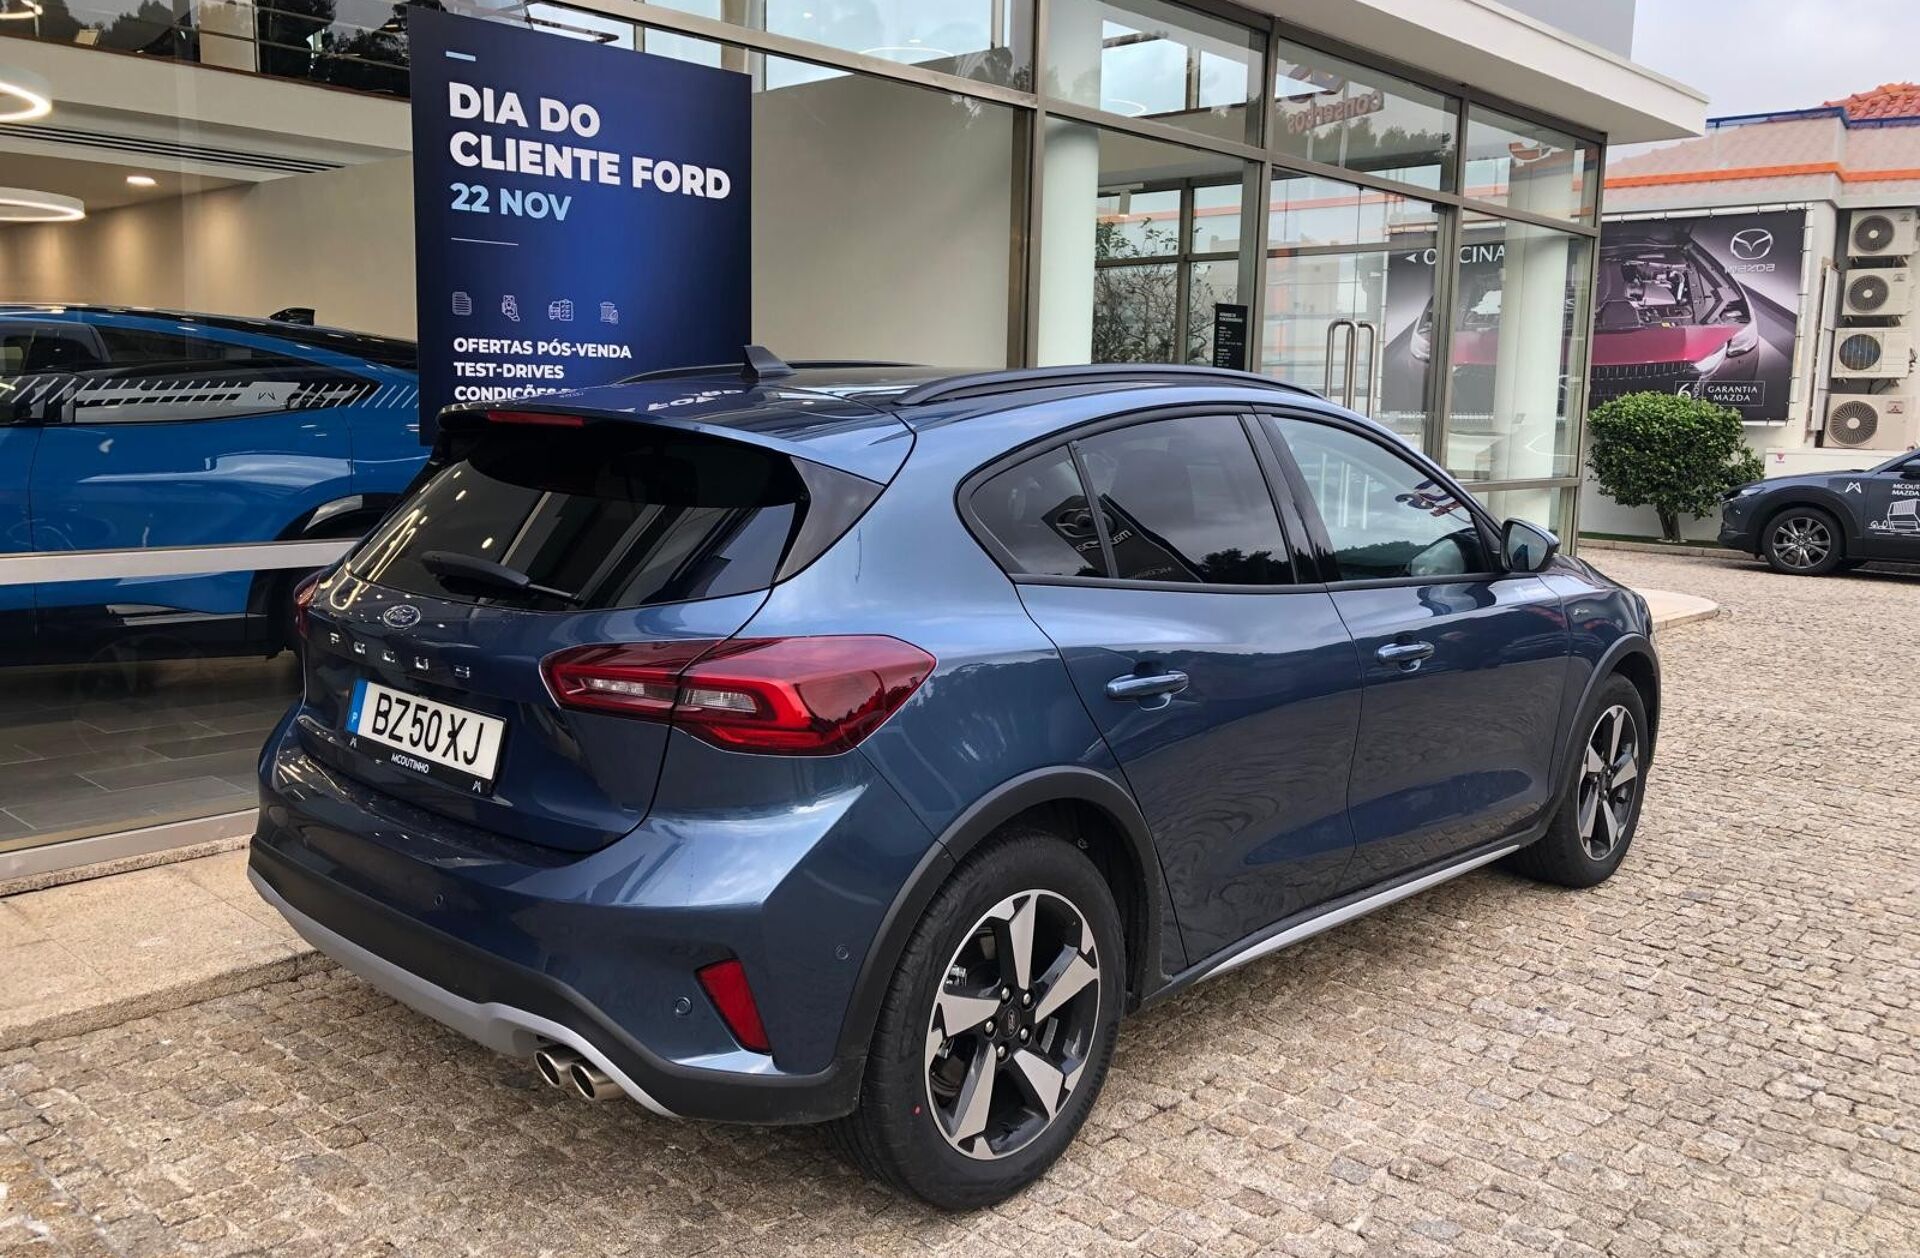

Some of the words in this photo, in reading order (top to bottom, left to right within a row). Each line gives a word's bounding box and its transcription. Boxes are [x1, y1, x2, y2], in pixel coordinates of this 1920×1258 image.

[449, 81, 528, 128] DIA
[540, 97, 600, 138] DO
[449, 131, 621, 186] CLIENTE
[632, 156, 731, 199] FORD
[450, 183, 490, 213] 22
[500, 188, 572, 221] NOV
[1423, 244, 1505, 265] OCINA
[453, 337, 533, 355] OFERTAS
[537, 338, 632, 359] PÓS-VENDA
[453, 361, 565, 379] TEST-DRIVES
[1707, 385, 1758, 394] GARANTIA
[1713, 394, 1751, 402] MAZDA
[390, 752, 430, 774] MCOUTINHO
